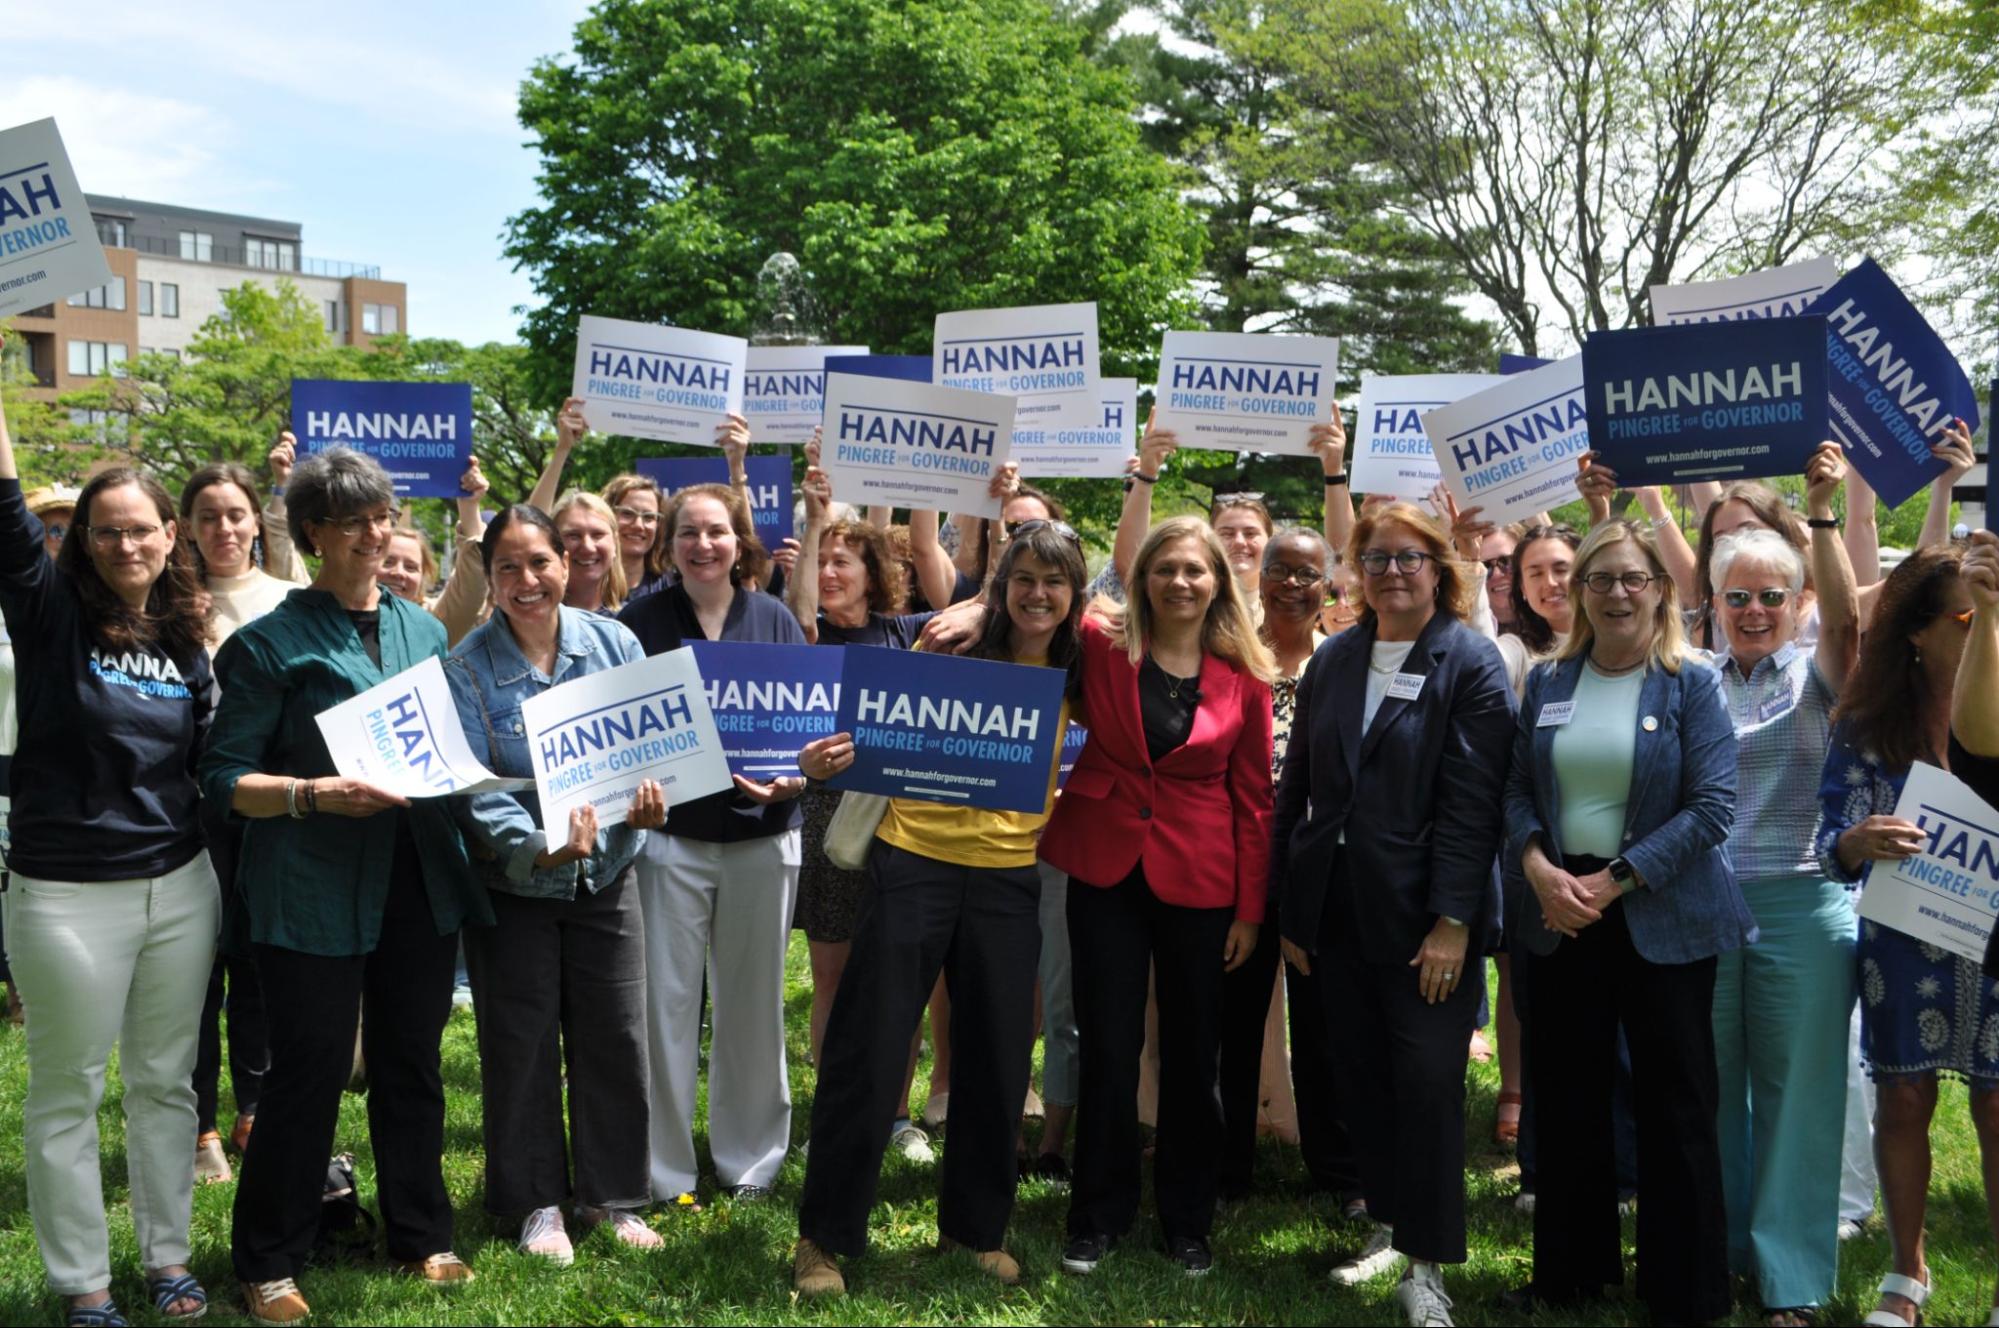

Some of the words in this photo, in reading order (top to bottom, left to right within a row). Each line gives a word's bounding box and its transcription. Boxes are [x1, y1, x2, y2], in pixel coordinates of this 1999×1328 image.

[590, 350, 731, 392] HANNAH
[943, 340, 1085, 374] HANNAH
[587, 379, 642, 399] PINGREE
[656, 388, 728, 411] GOVERNOR
[744, 375, 822, 396] HANN
[1009, 371, 1085, 391] GOVERNOR
[1172, 364, 1319, 397] HANNAH
[1604, 361, 1802, 415] HANNAH
[743, 399, 788, 412] PINGREE
[1170, 393, 1226, 411] PINGREE
[1241, 398, 1316, 417] GOVERNOR
[1607, 413, 1681, 440] PINGREE
[1683, 415, 1698, 426] FOR
[1701, 401, 1804, 430] GOVERNOR
[307, 411, 456, 440] HANNAH
[840, 412, 995, 456] HANNAH
[1058, 431, 1122, 445] GOVERNOR
[1195, 423, 1288, 438] www.hannahforgovernor.com
[1452, 398, 1587, 472] HANNA
[1864, 388, 1932, 465] GOVERNOR
[380, 442, 456, 458] GOVERNOR
[837, 444, 896, 466] PINGREE
[911, 451, 991, 477] GOVERNOR
[1646, 444, 1770, 464] www.hannahforgovernor.com
[862, 478, 959, 497] www.hannahforgovernor.com
[1463, 455, 1528, 493] PINGREE
[771, 716, 836, 733] GOVERN
[857, 688, 1040, 741] HANNAH
[541, 693, 693, 773] HANNAH
[854, 726, 925, 753] PINGREE
[926, 739, 941, 749] FOR
[942, 736, 1033, 764] GOVERNOR
[547, 761, 594, 798] PINGREE
[608, 729, 699, 772] GOVERNOR
[882, 766, 997, 787] www.hannahforgovernor.com
[1910, 814, 1999, 881] HAN
[1897, 855, 1973, 898] PINGREE
[1973, 886, 1989, 898] FOR
